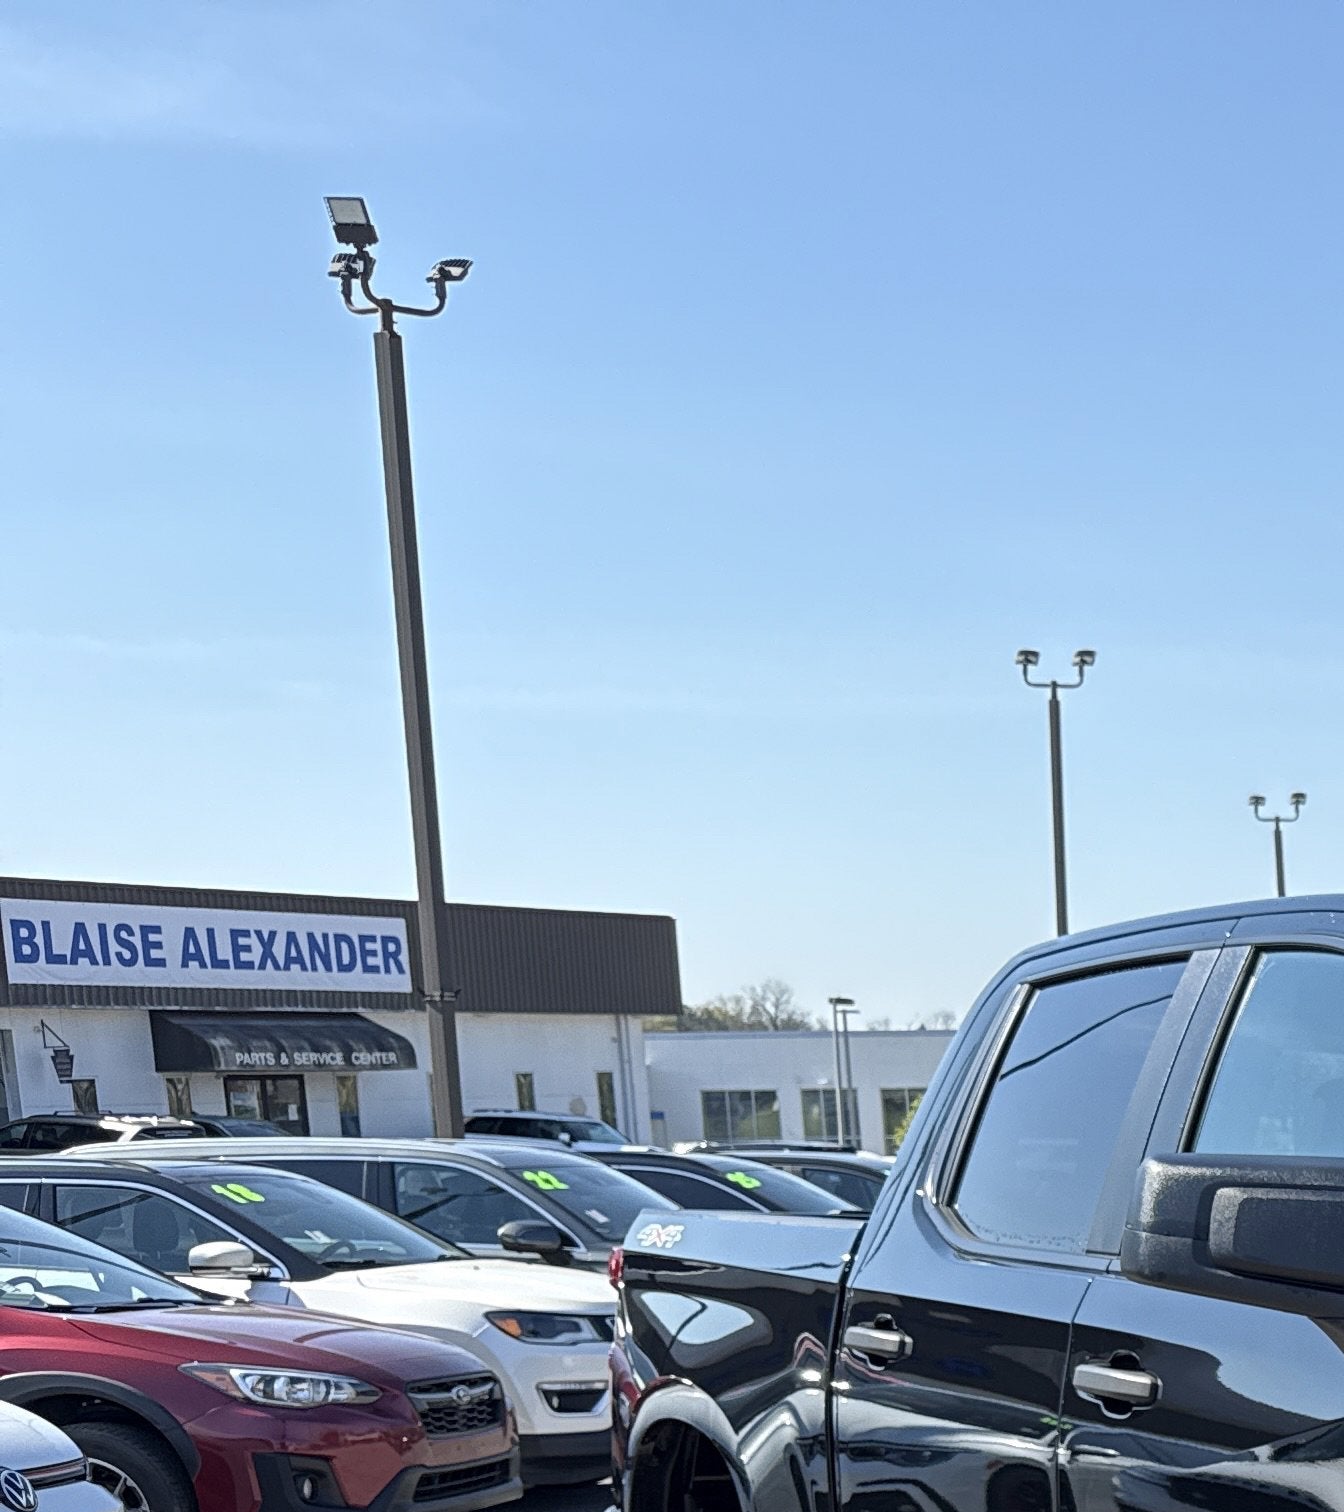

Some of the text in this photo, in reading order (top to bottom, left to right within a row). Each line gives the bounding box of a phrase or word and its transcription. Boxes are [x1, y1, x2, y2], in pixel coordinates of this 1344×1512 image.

[10, 919, 406, 975] BLAISE ALEXANDER
[235, 1052, 398, 1066] PARTS & SERVICE CENTER
